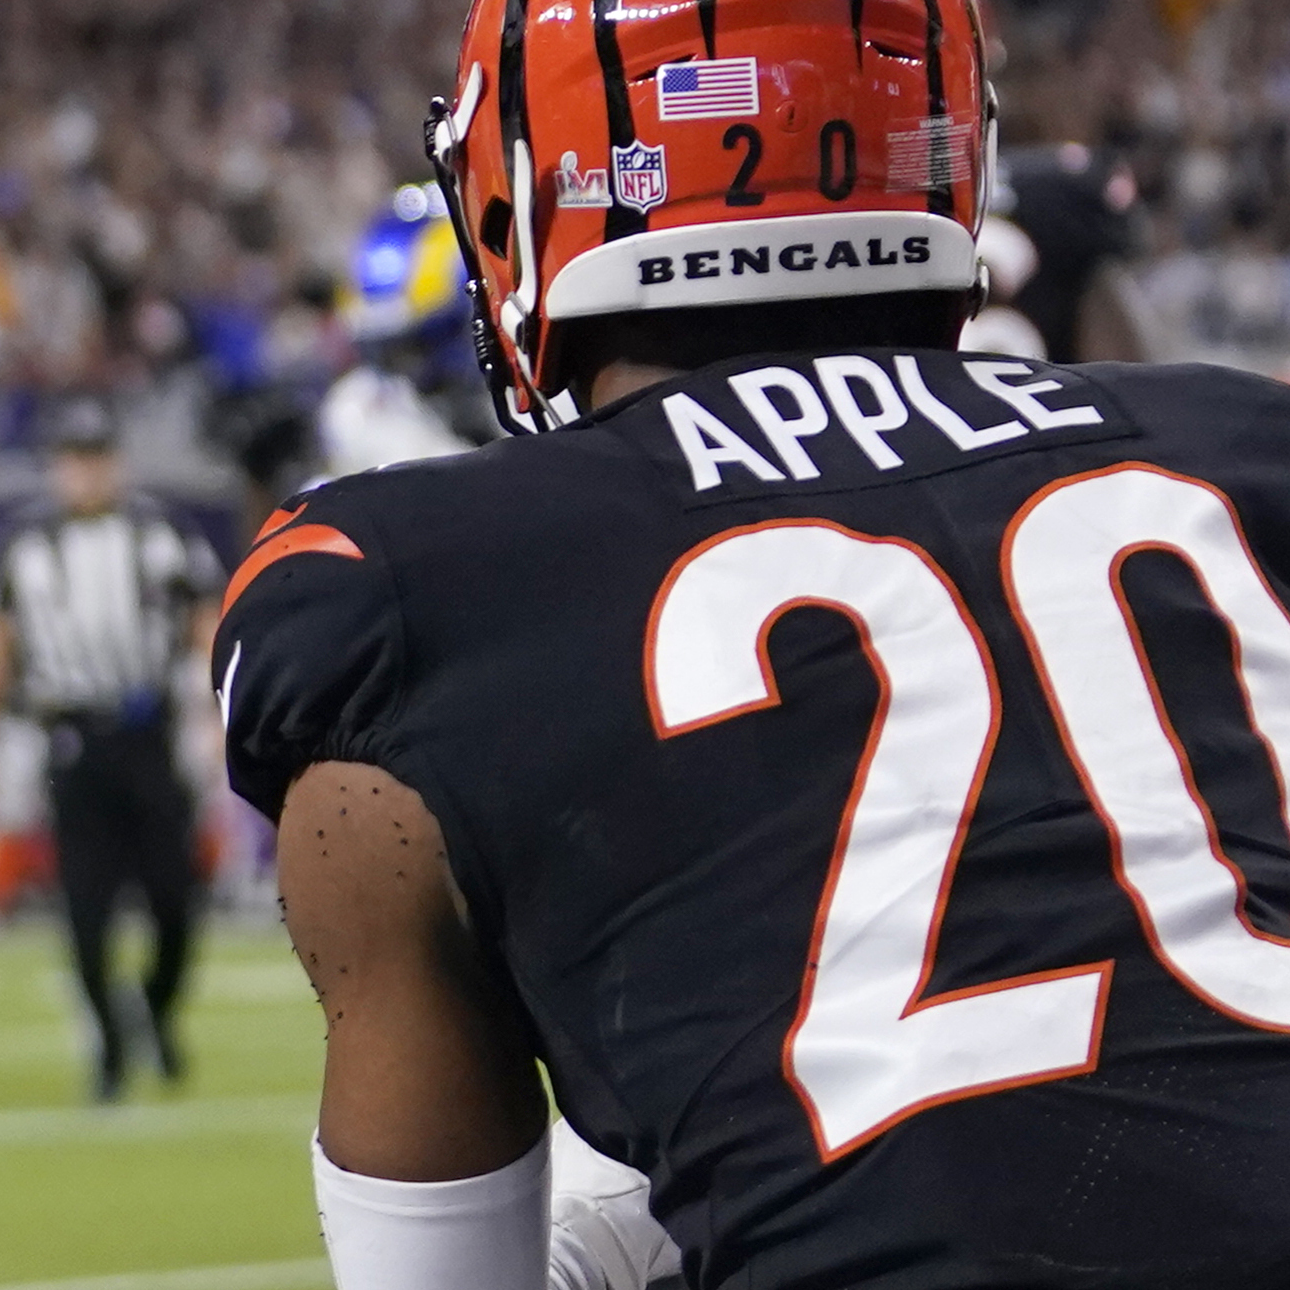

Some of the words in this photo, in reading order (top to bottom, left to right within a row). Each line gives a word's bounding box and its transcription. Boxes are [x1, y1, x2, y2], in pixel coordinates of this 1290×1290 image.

[622, 171, 661, 201] NFL
[638, 235, 932, 286] BENGALS
[662, 354, 1105, 492] APPLE
[643, 460, 1290, 1164] 20
